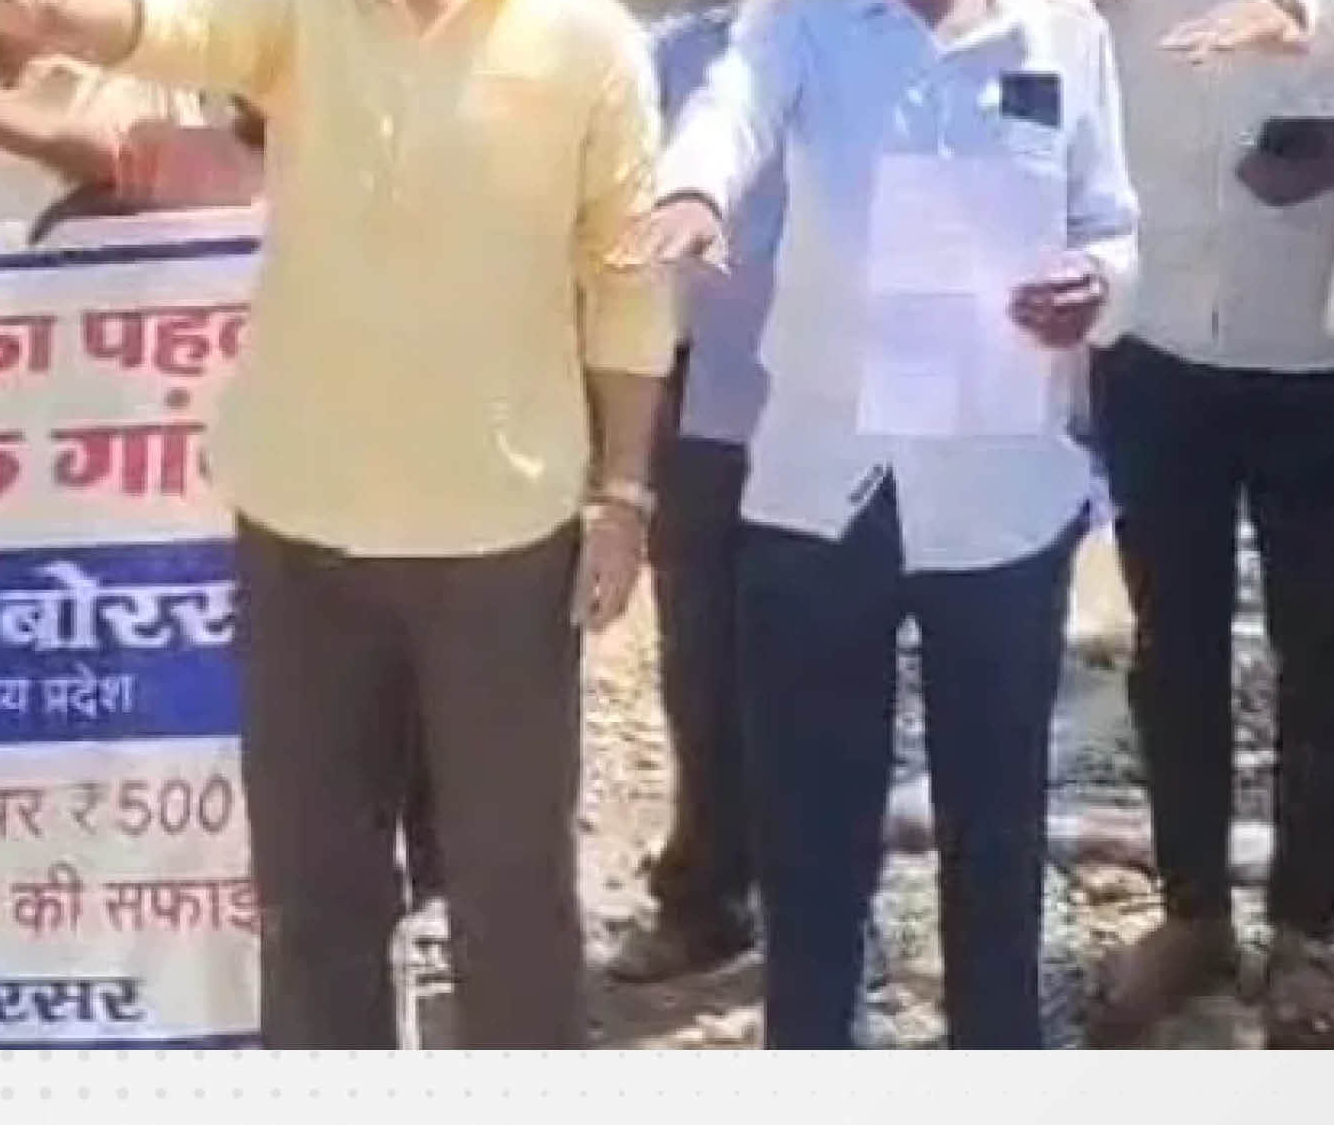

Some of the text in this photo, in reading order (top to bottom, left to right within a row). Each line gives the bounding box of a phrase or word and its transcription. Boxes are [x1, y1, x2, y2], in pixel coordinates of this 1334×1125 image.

[47, 386, 212, 497] गां
[43, 661, 134, 718] प्रदेश
[12, 861, 82, 938] की
